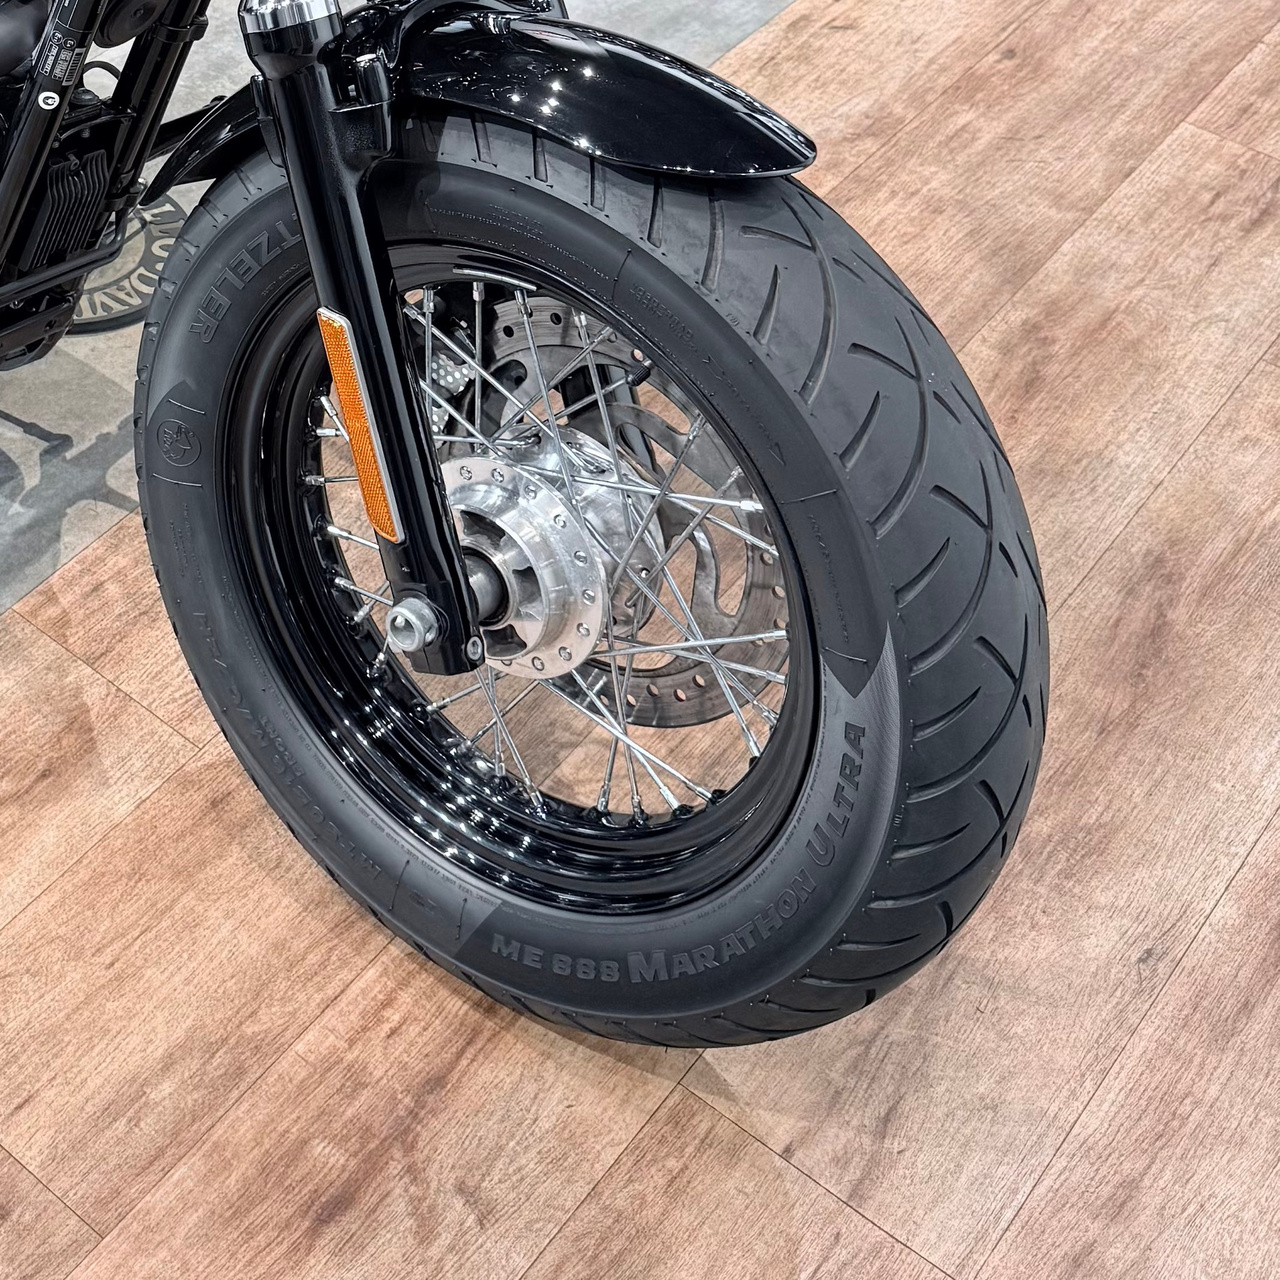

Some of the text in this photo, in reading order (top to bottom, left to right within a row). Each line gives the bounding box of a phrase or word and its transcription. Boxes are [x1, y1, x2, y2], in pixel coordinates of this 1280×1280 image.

[188, 213, 303, 344] TZELER
[490, 933, 545, 969] ME
[552, 953, 622, 983] 888
[626, 866, 817, 984] MARATHON
[805, 720, 866, 867] ULTRA
